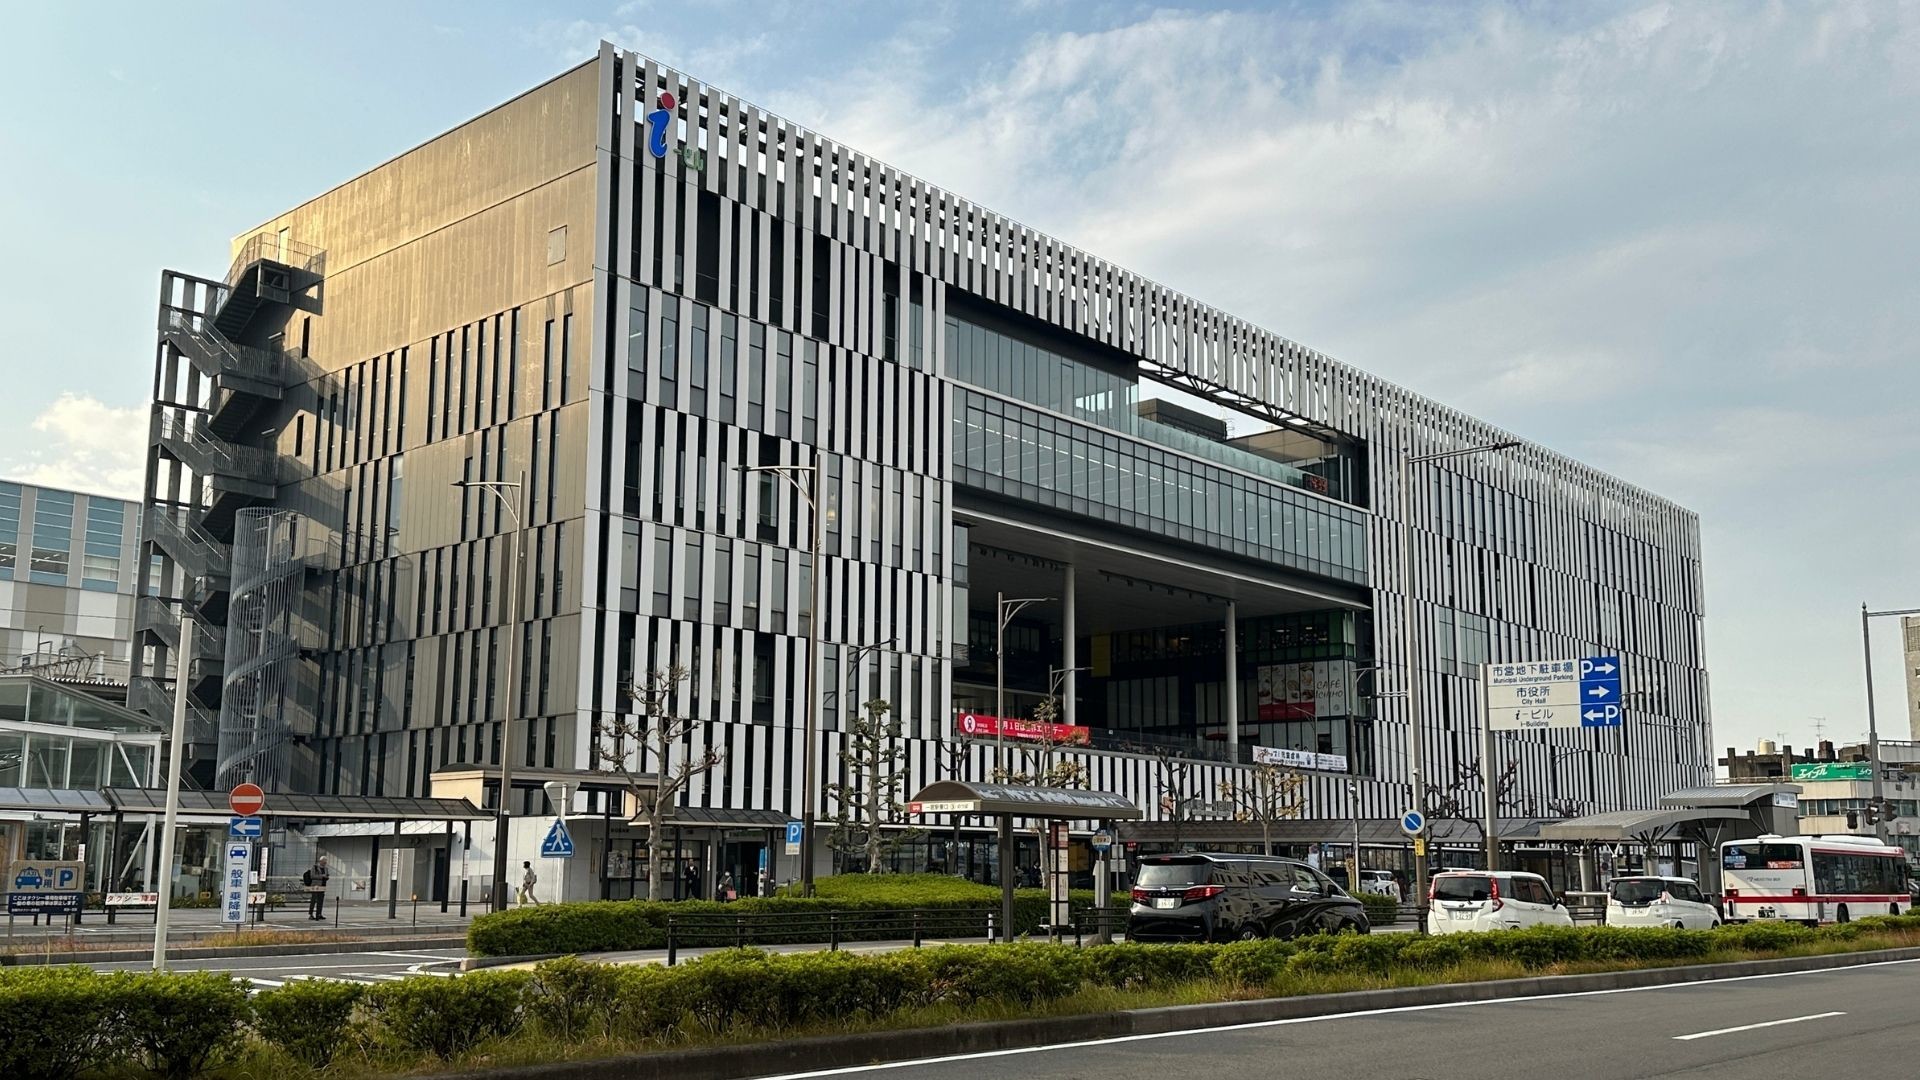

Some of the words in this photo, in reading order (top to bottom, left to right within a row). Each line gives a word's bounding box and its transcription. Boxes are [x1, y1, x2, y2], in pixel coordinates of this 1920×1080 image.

[1492, 661, 1574, 677] 市営地下駐車場
[1580, 660, 1594, 680] P
[1516, 685, 1550, 698] 市役所
[1605, 704, 1618, 724] P
[790, 824, 799, 842] P
[59, 870, 74, 887] P
